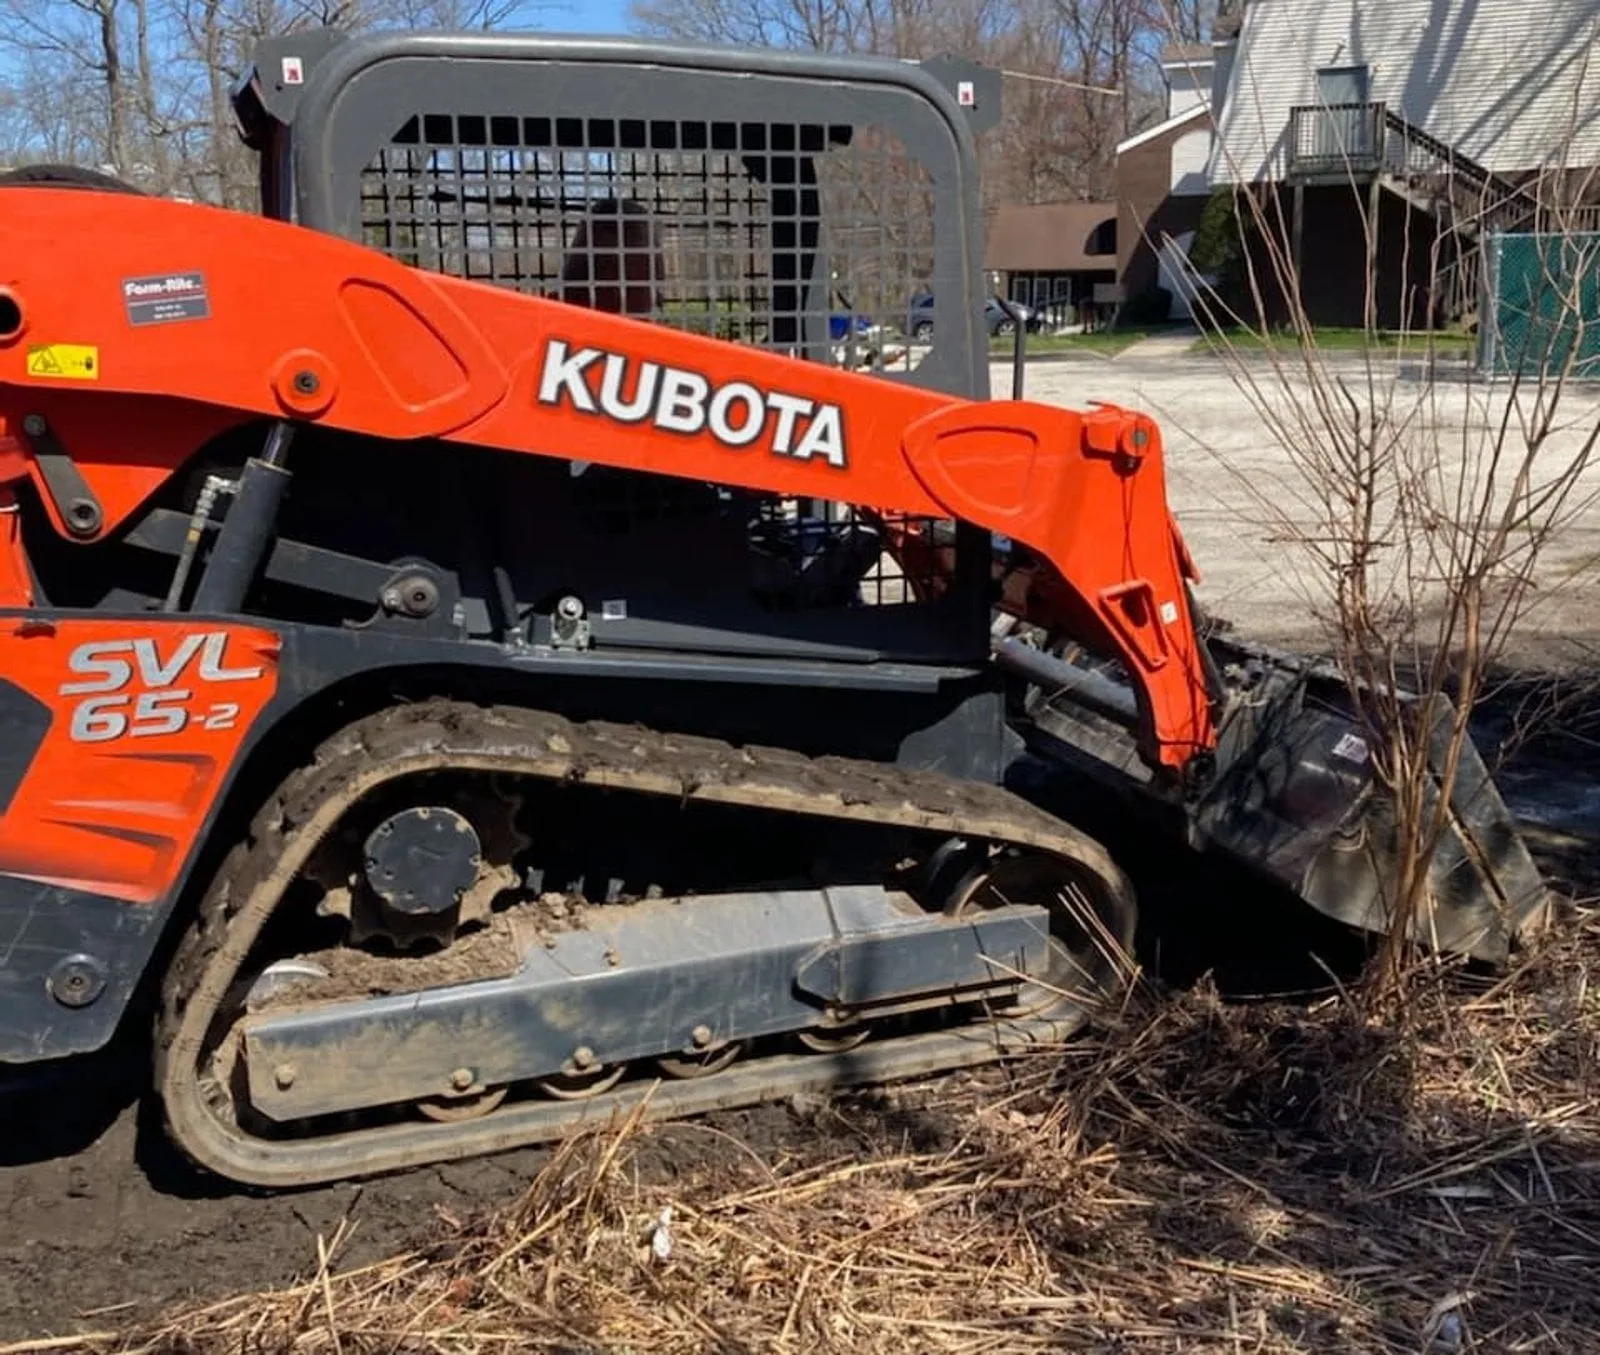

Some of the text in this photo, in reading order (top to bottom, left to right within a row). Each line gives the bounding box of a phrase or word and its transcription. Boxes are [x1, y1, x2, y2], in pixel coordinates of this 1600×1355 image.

[538, 339, 847, 467] KUBOTA
[59, 631, 263, 697] SVL
[70, 689, 240, 742] 65-2
